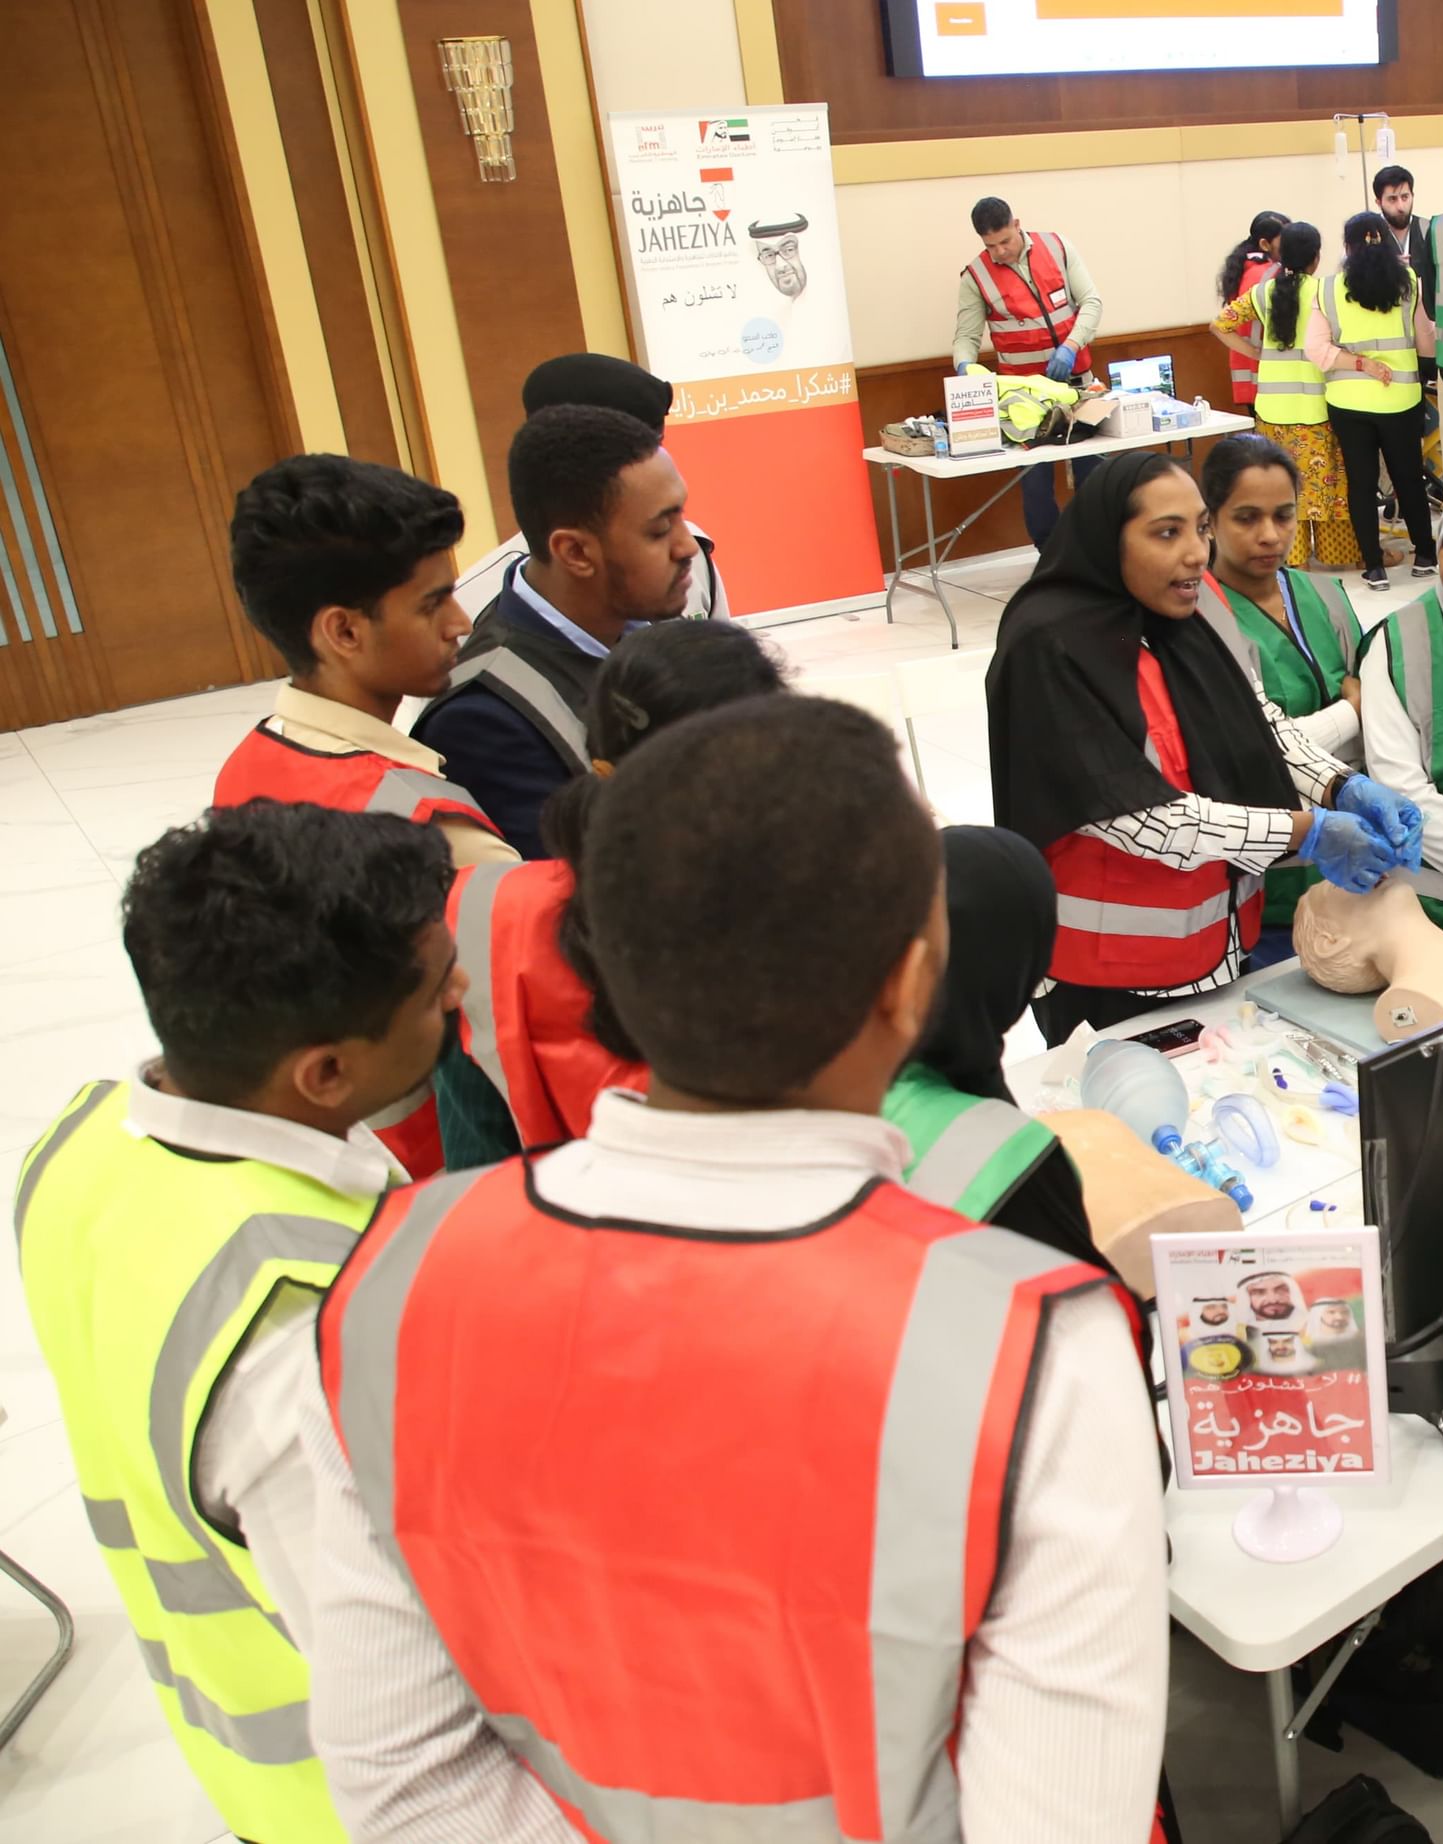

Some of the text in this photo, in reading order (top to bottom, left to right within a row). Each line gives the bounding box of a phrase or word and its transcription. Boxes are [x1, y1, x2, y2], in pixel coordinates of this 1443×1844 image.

[631, 190, 707, 221] جاهزية
[638, 221, 737, 254] JAHEZIYA
[662, 293, 678, 311] هم
[669, 372, 852, 419] #شكرا_محمد_بن_زاي
[950, 389, 993, 401] JAHEZIYA
[1193, 1400, 1366, 1451] جاهزية
[1194, 1449, 1364, 1473] Jaheziya
